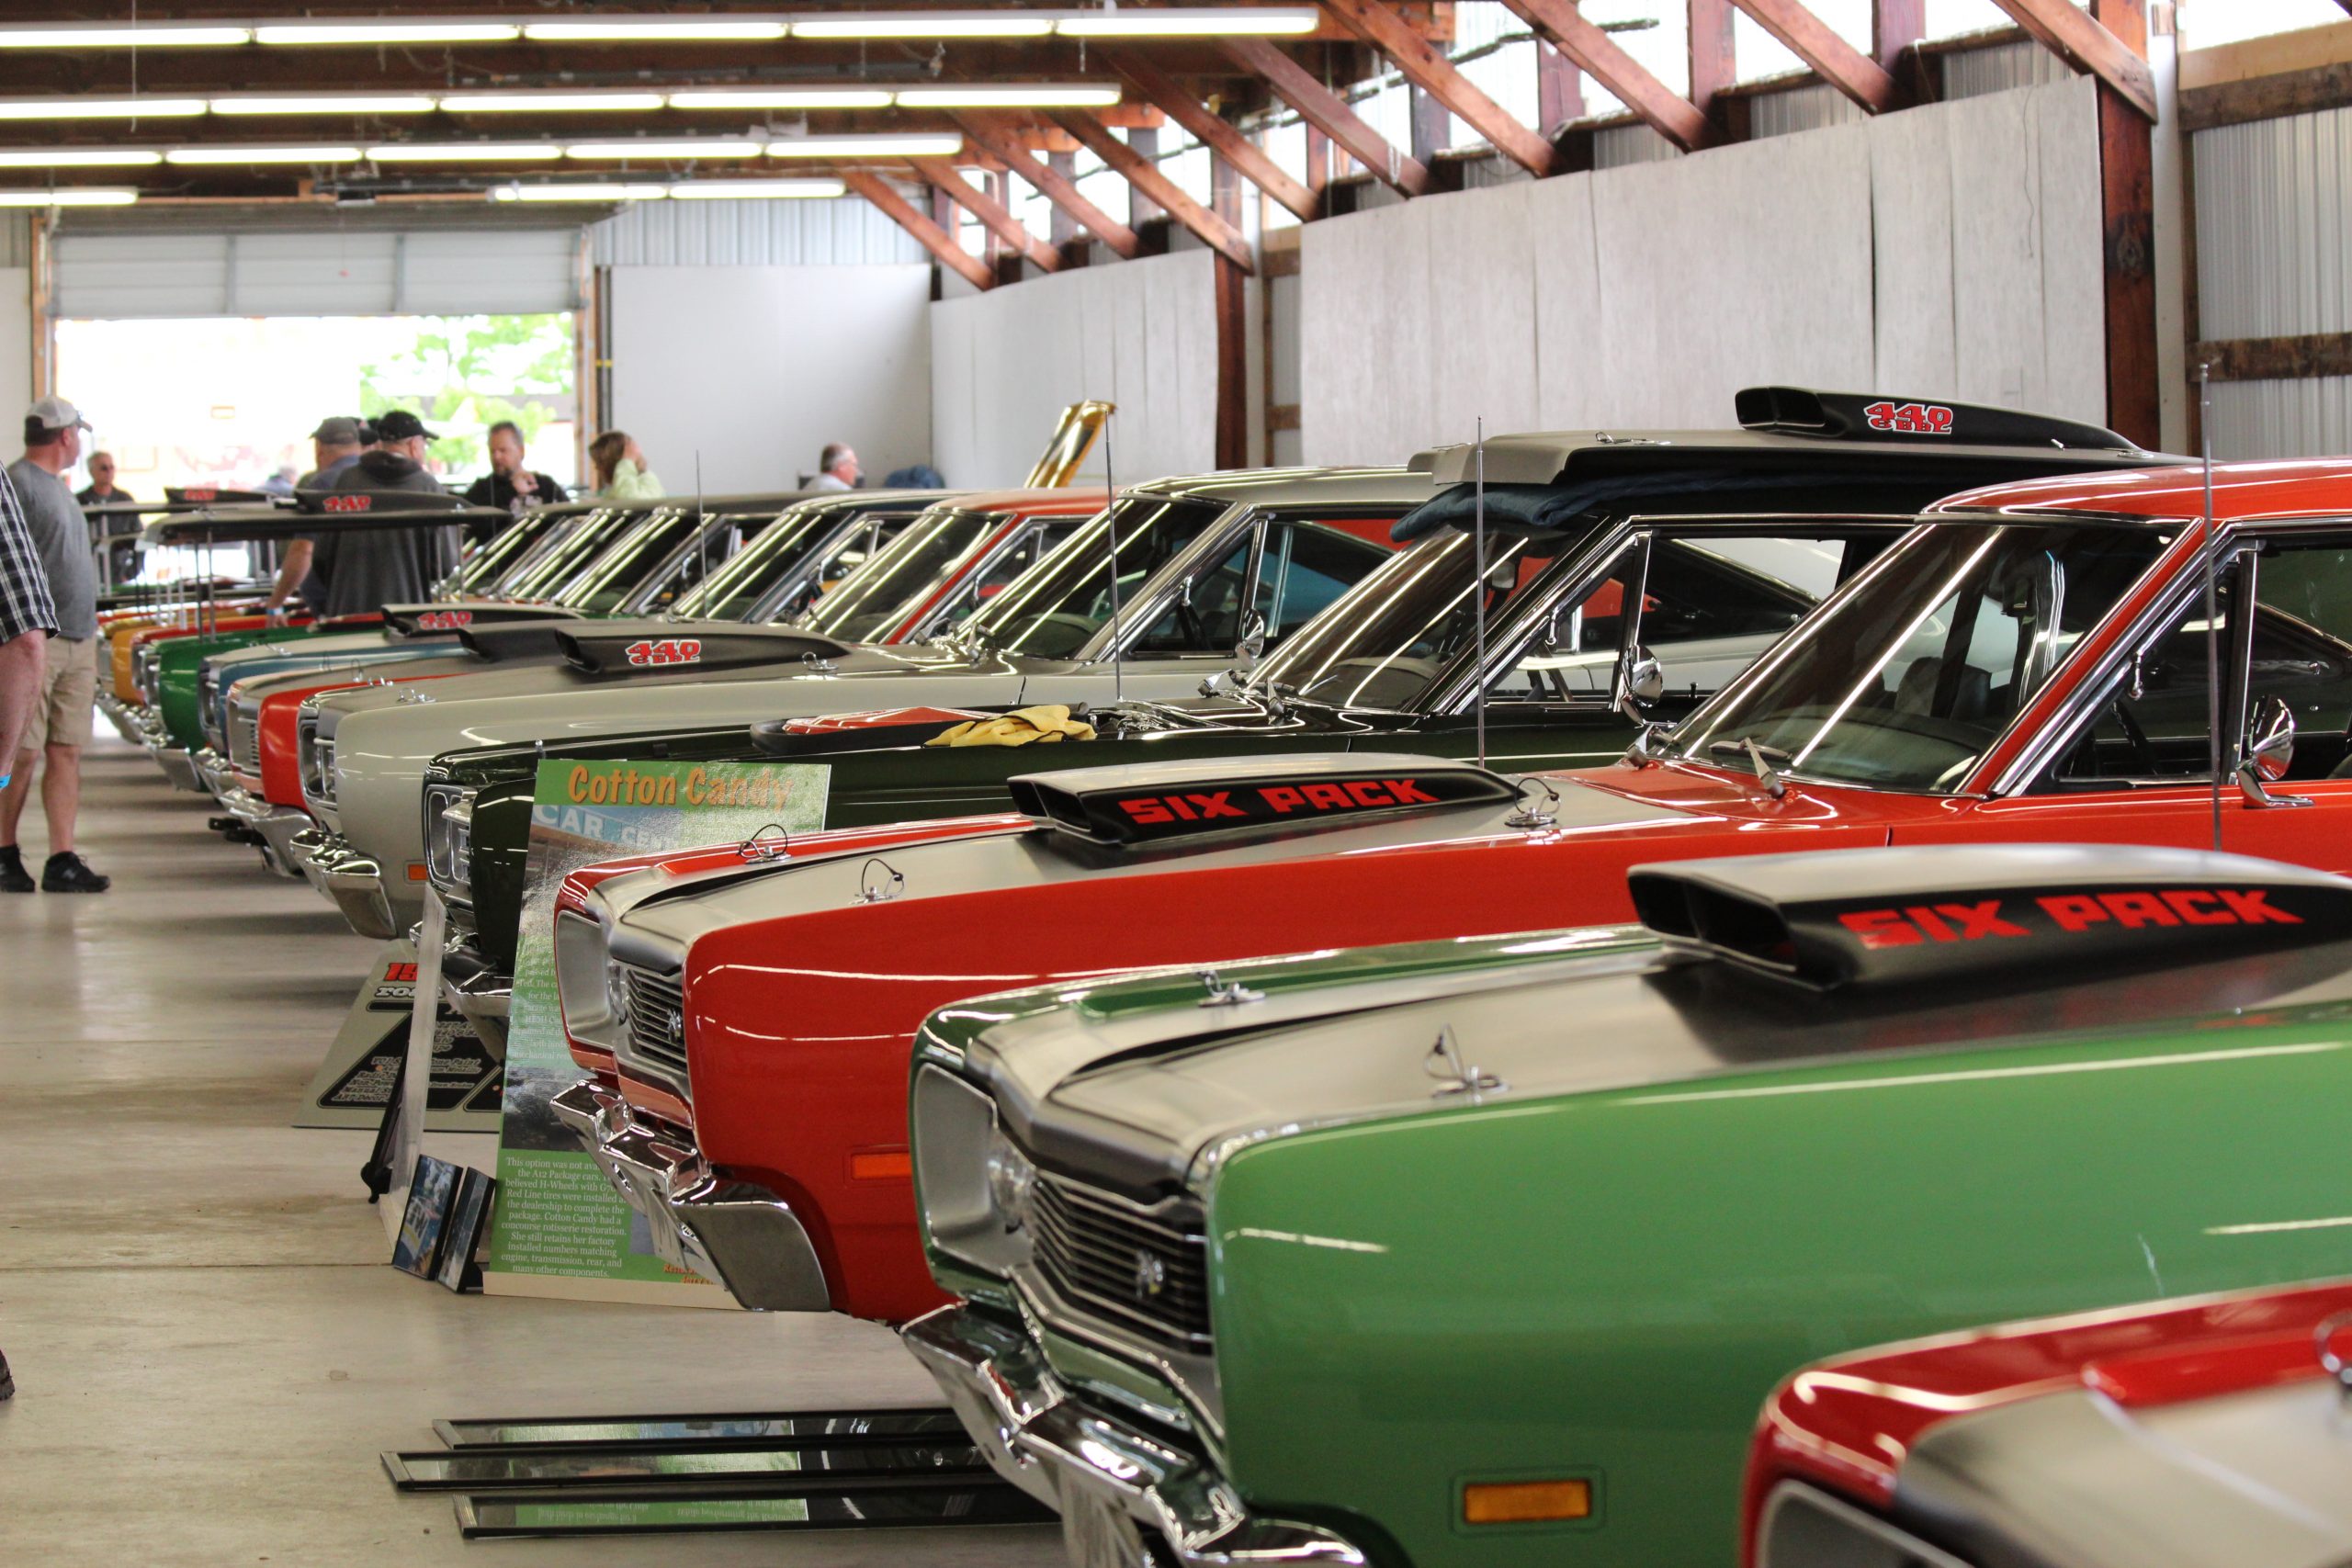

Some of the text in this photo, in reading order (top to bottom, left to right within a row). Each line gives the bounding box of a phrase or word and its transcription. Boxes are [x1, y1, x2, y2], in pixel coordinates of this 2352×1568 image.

[1863, 401, 1953, 425] 440
[625, 639, 701, 659] 440
[568, 764, 795, 813] Cotton Candy
[1118, 778, 1442, 824] SIX PACK
[533, 805, 604, 839] CAR
[1838, 889, 2305, 950] SIX PACK
[506, 1157, 523, 1167] This
[525, 1158, 551, 1169] option
[553, 1161, 567, 1169] was
[570, 1161, 582, 1169] not
[517, 1168, 530, 1177] the
[549, 1169, 581, 1182] Package
[505, 1177, 538, 1188] believed
[539, 1179, 579, 1190] H-Wheels
[581, 1181, 598, 1191] with
[507, 1189, 523, 1198] Red
[525, 1190, 541, 1199] Line
[544, 1190, 560, 1199] tires
[562, 1193, 582, 1201] were
[584, 1193, 617, 1203] installed
[507, 1200, 625, 1215] the dealership to complete the
[544, 1212, 571, 1222] Cotton
[573, 1213, 596, 1225] Candy
[600, 1214, 615, 1224] had
[501, 1223, 541, 1231] concourse
[543, 1224, 580, 1233] rotisserie
[511, 1232, 616, 1248] She still retains her factory
[508, 1242, 617, 1258] installed numbers matching
[513, 1266, 533, 1274] many
[536, 1265, 558, 1274] other
[607, 1258, 622, 1268] and
